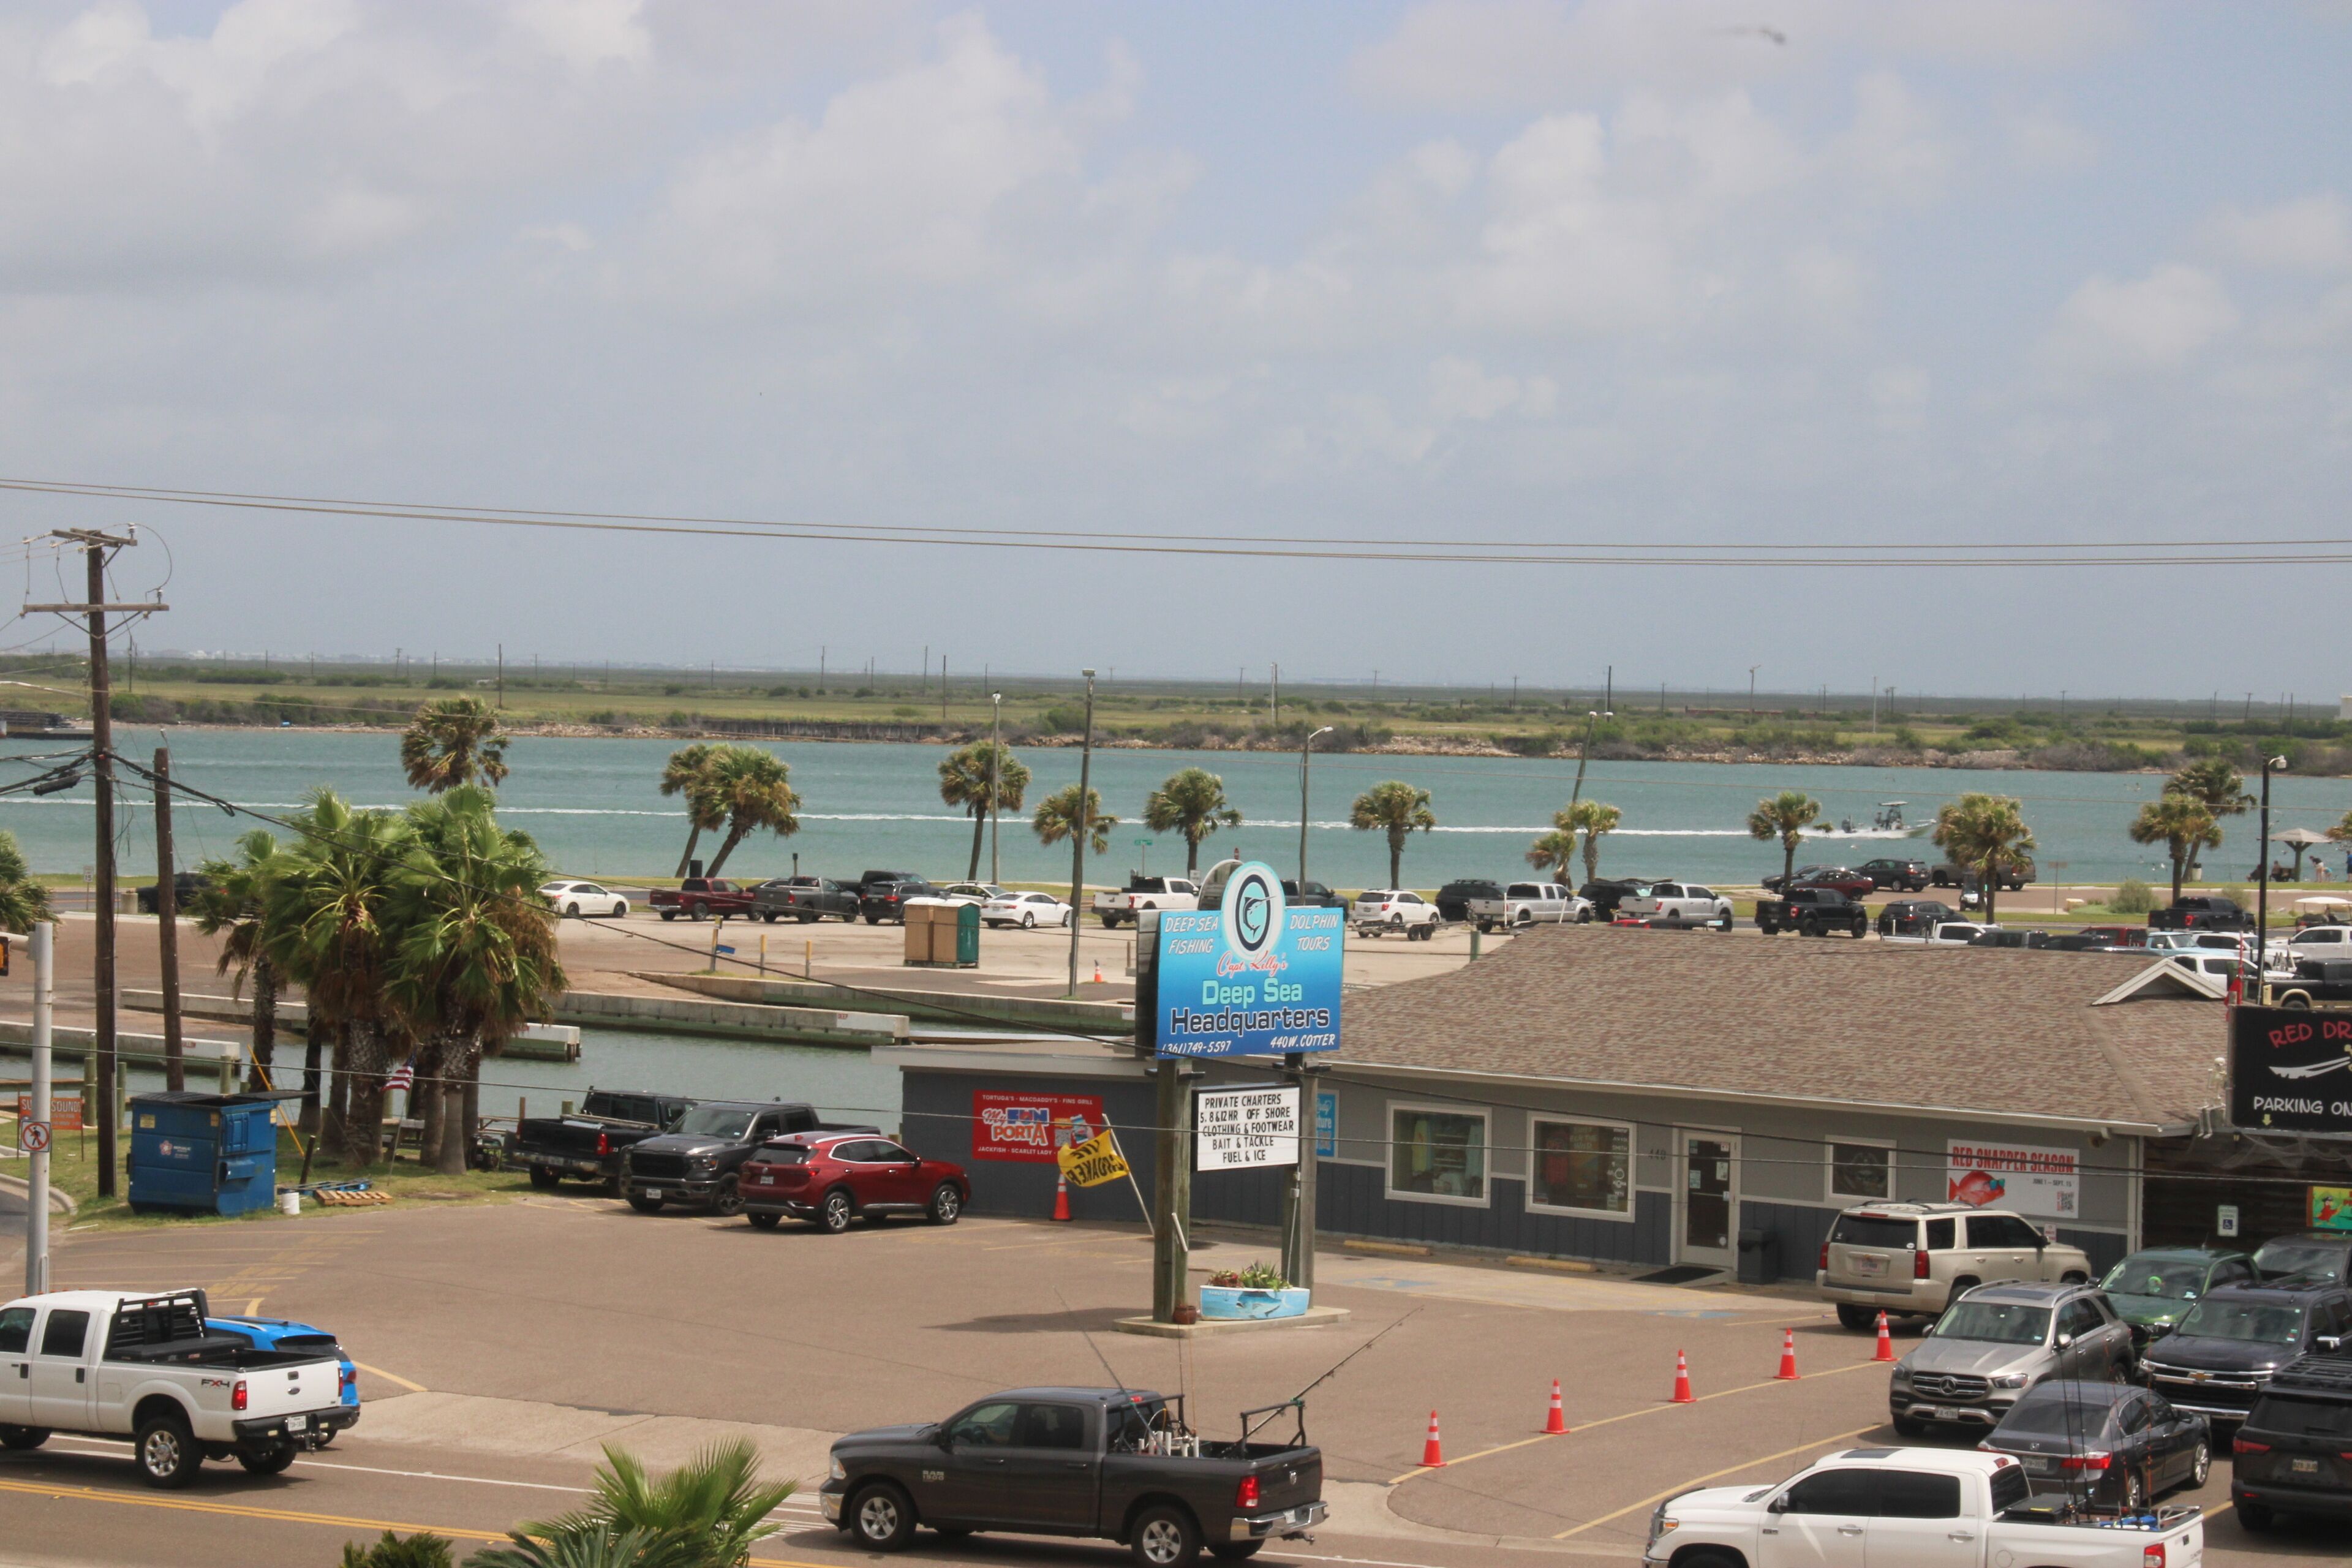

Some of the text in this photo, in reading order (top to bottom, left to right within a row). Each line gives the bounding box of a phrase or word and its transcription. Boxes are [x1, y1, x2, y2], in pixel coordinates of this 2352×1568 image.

[1165, 916, 1220, 932] DEEP SEA
[1290, 914, 1340, 930] DOLPHIN
[1168, 938, 1215, 954] FISHING
[1297, 937, 1331, 951] TOURS
[1216, 951, 1288, 978] Capt. Kelly's
[1202, 977, 1302, 1009] Deep Sea
[1170, 1006, 1330, 1037] Headquarters
[2268, 1023, 2313, 1048] RED
[1205, 1093, 1281, 1109] PRIVATE CHARTERS
[2253, 1096, 2324, 1114] PARKING
[1246, 1109, 1260, 1120] OFF
[1265, 1107, 1291, 1118] SHORE
[1203, 1120, 1294, 1137] CLOTHING & FOOTWEAR
[1212, 1136, 1274, 1150] BAIT & TACKLE
[1223, 1150, 1266, 1163] FUEL & ICE
[1953, 1146, 2075, 1175] RED SNAPPER SEASON
[201, 1379, 230, 1388] FX4
